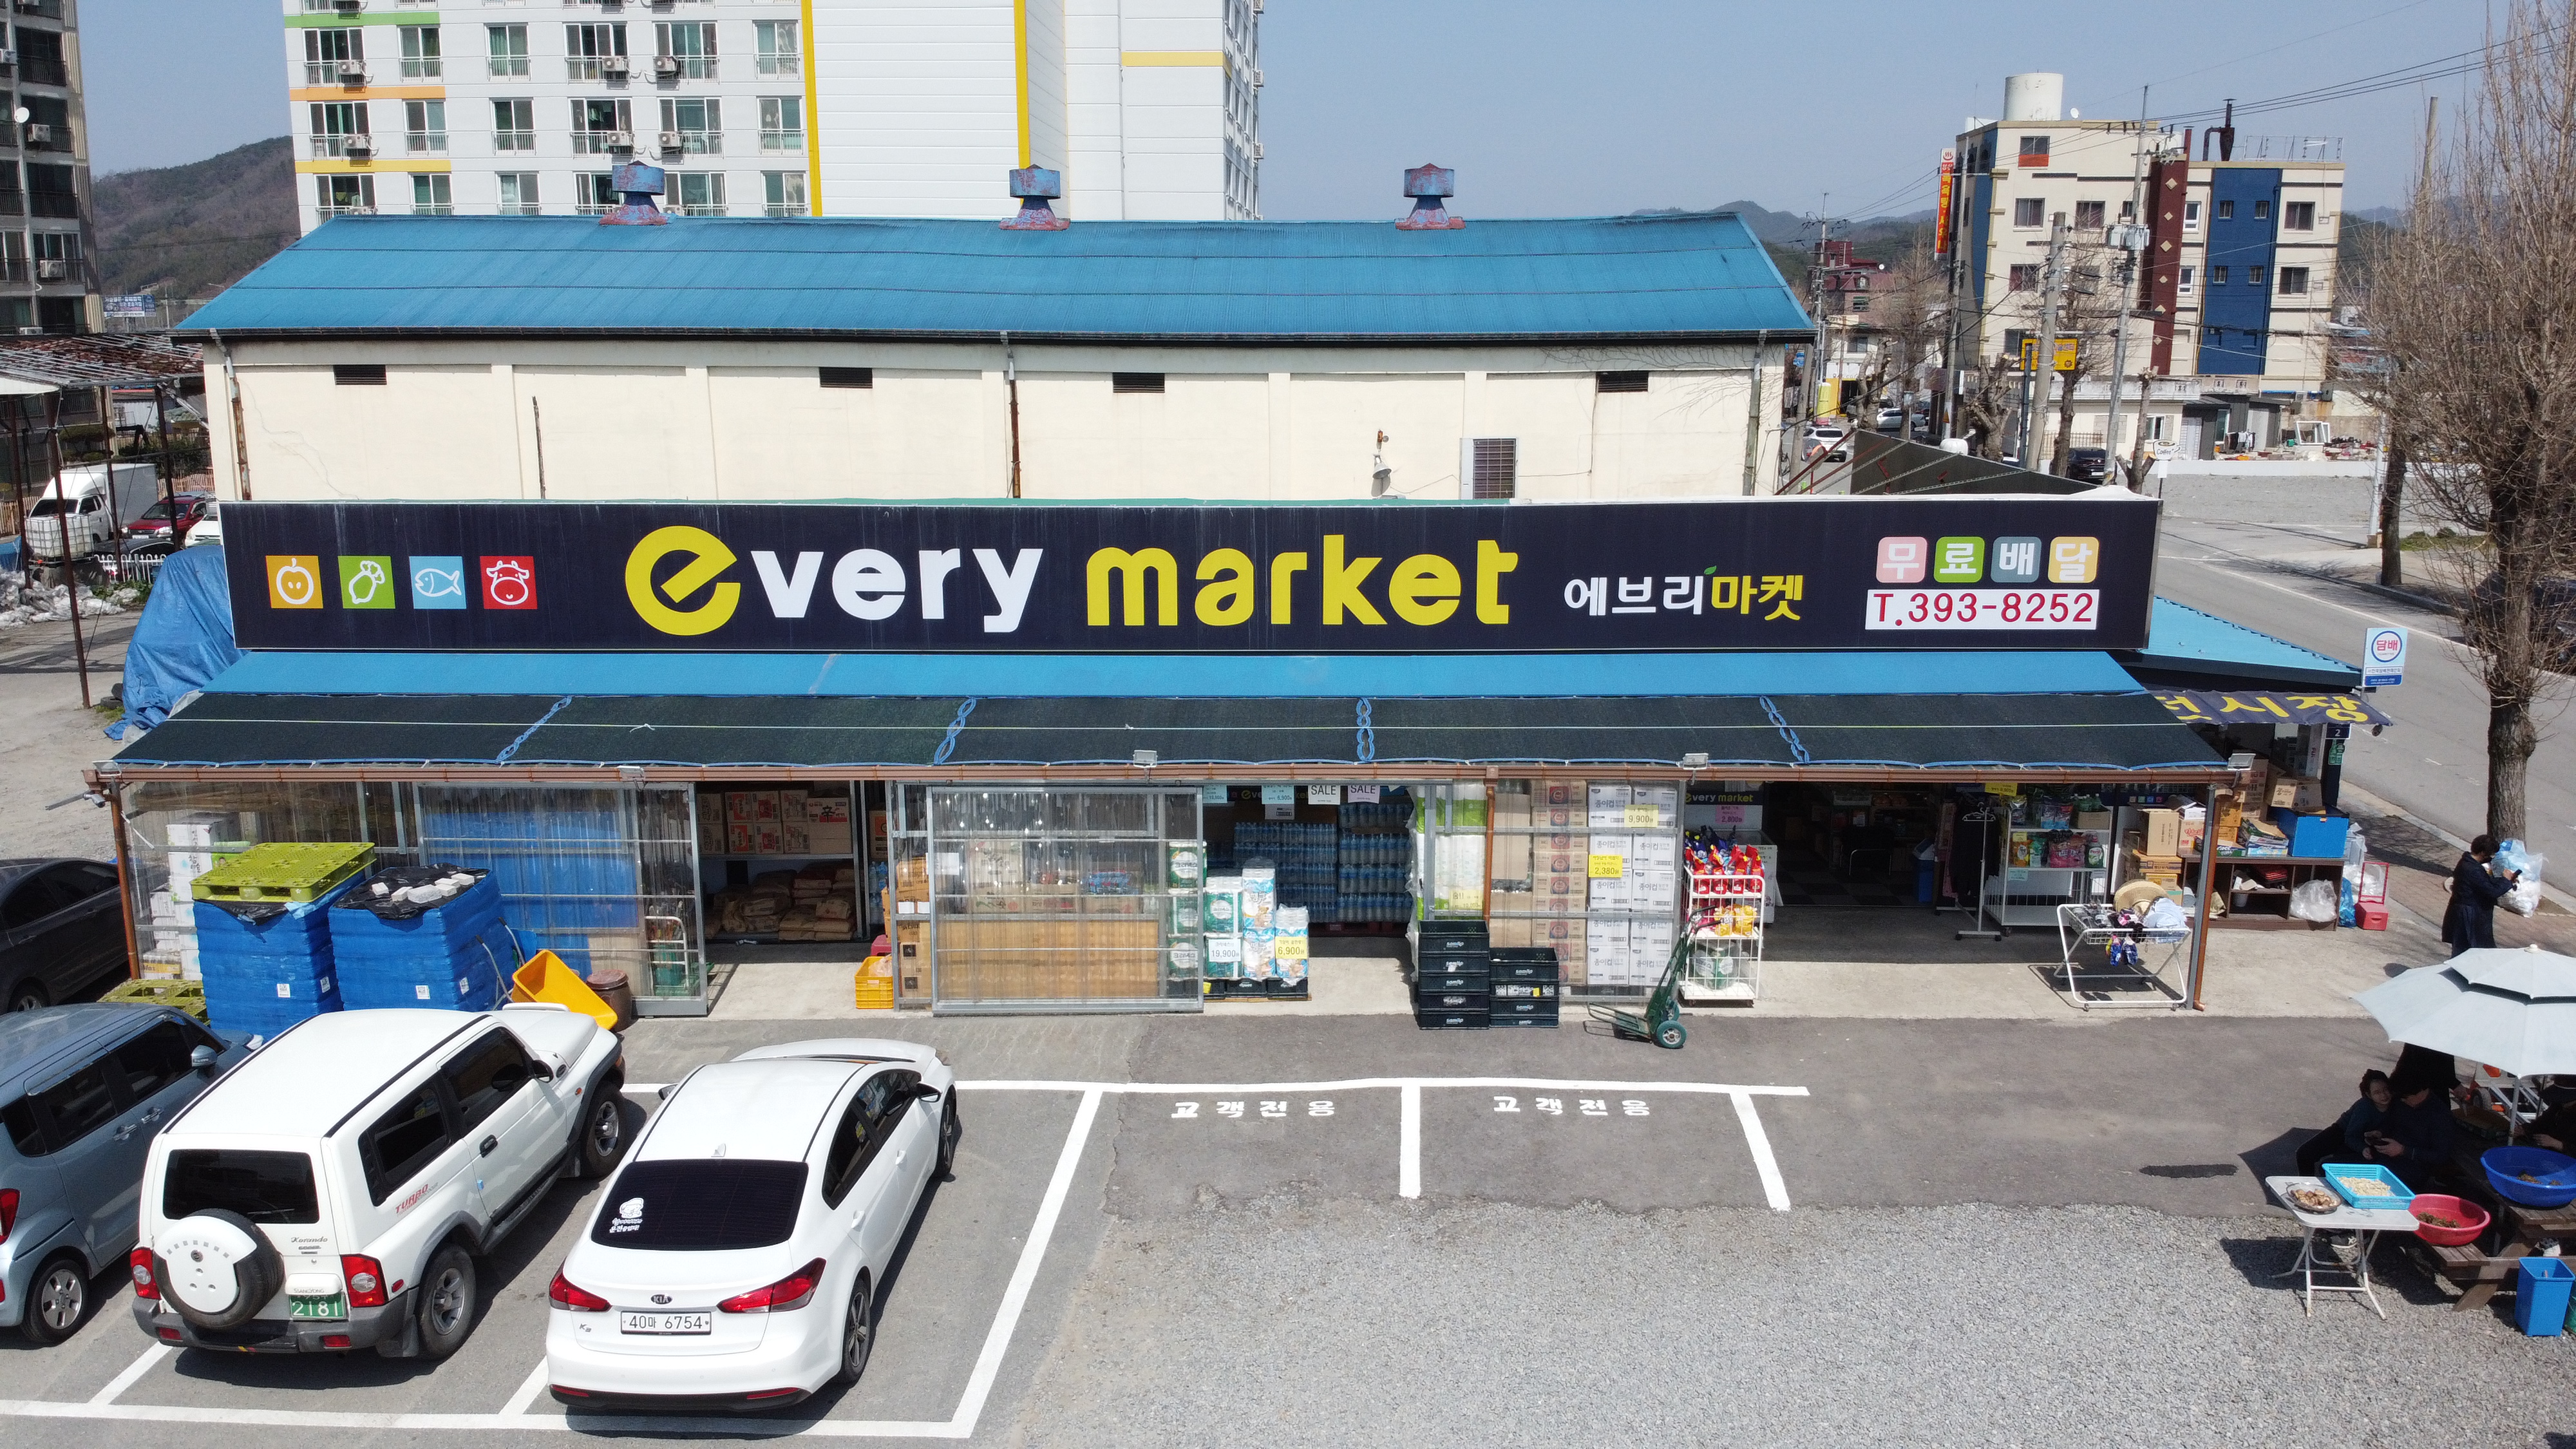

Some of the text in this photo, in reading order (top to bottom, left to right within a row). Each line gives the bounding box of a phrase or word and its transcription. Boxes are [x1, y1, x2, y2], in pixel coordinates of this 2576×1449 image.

[1882, 542, 2093, 582] 무료배달
[625, 526, 1519, 636] every market
[1564, 574, 1804, 622] 에브리마켓
[1873, 592, 2092, 627] T.393-8252
[2376, 639, 2398, 651] 담배
[2334, 728, 2341, 737] 2
[1311, 785, 1336, 795] SALE
[1350, 785, 1376, 794] SALE
[1595, 800, 1615, 808] 종이컵
[1718, 794, 1754, 802] market
[1639, 883, 1658, 891] 종이컵
[1211, 949, 1240, 958] 19,900원
[1278, 946, 1305, 956] 6,900원
[1170, 1101, 1336, 1120] 고객전용
[1493, 1095, 1650, 1116] 고객전용
[395, 1184, 428, 1214] TURBO
[292, 1301, 338, 1316] 2181
[629, 1315, 703, 1329] 40마 6754
